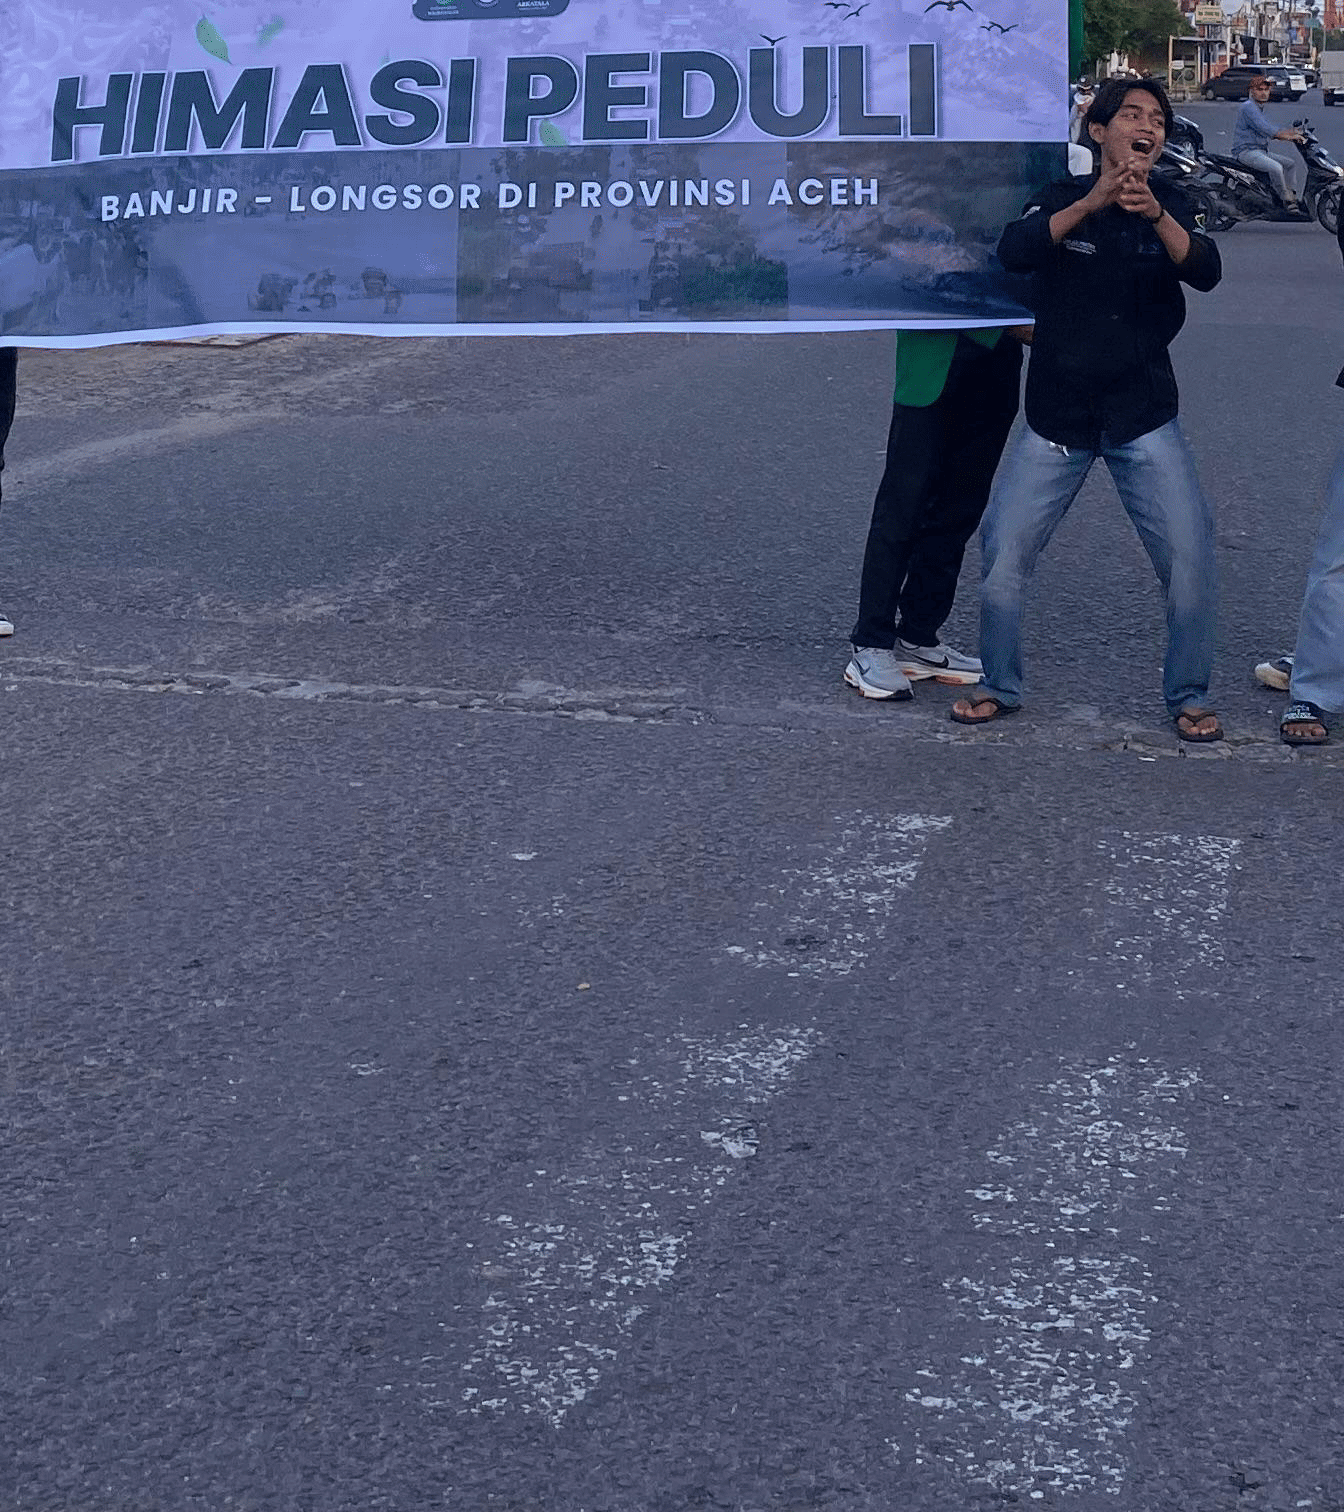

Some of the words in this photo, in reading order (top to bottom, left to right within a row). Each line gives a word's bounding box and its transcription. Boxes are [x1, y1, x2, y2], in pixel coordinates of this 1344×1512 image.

[50, 57, 477, 163] HIMASI
[501, 42, 939, 144] PEDULI
[100, 188, 239, 222] BANJIR
[289, 184, 481, 213] LONGSOR
[498, 182, 537, 209] DI
[554, 178, 751, 208] PROVINSI
[767, 177, 879, 207] ACEH
